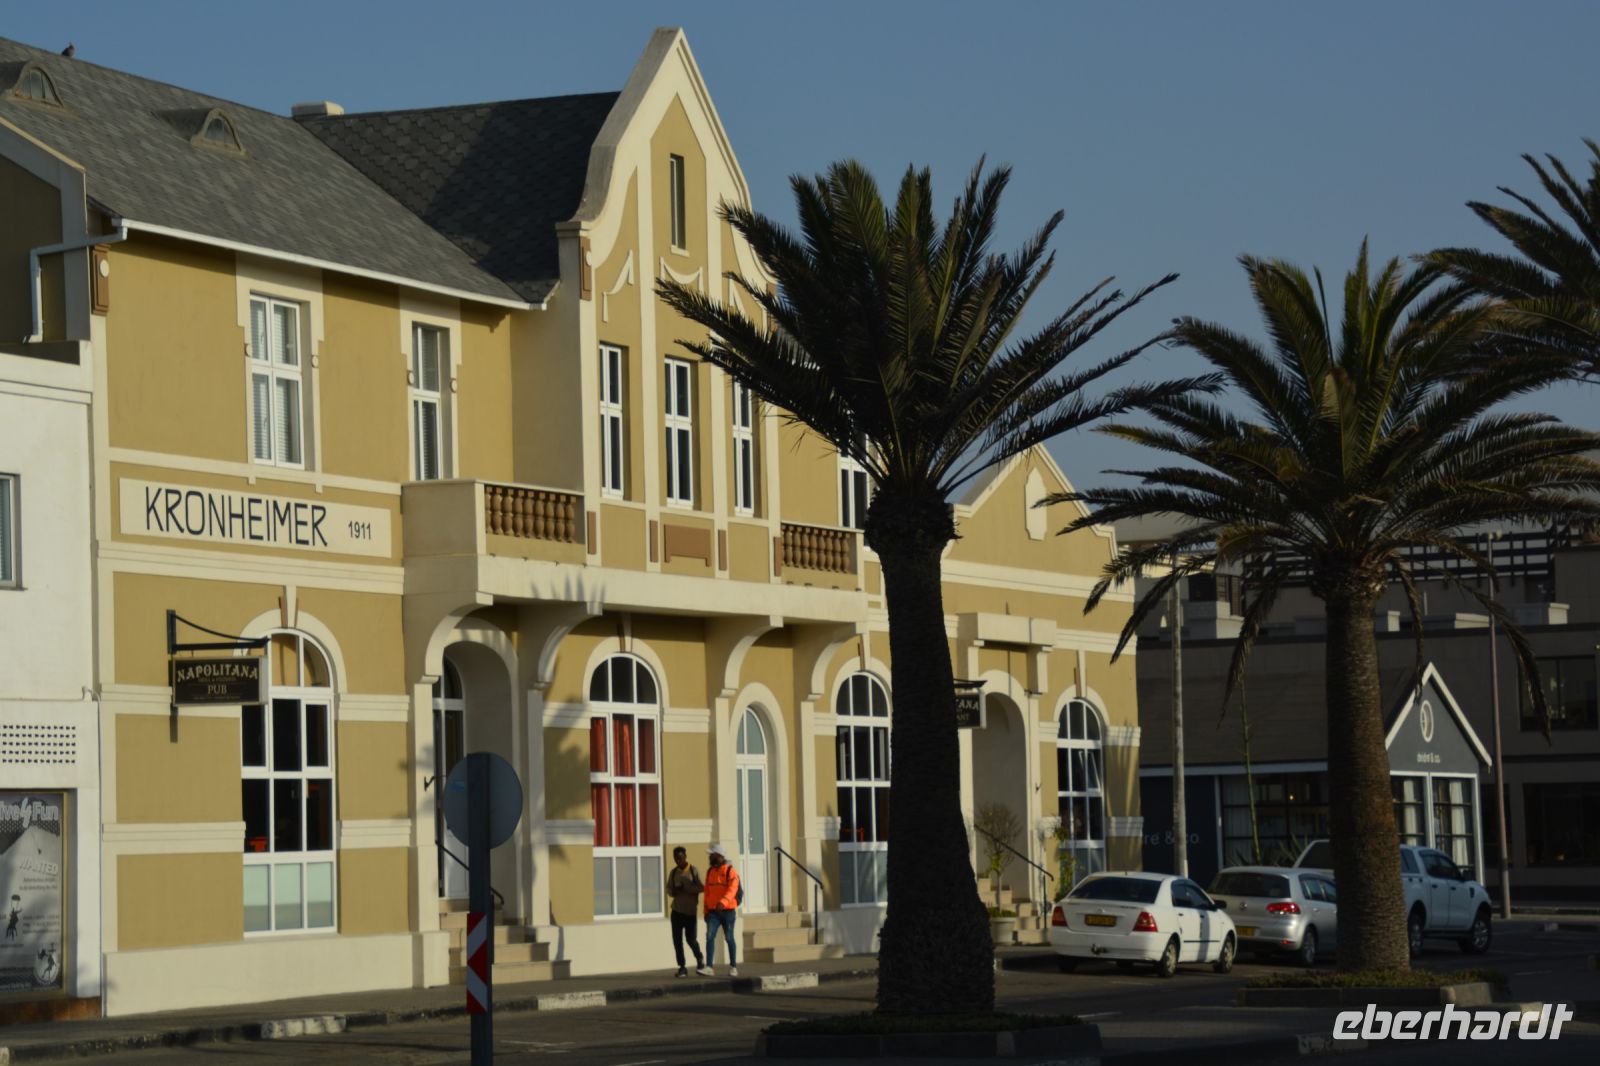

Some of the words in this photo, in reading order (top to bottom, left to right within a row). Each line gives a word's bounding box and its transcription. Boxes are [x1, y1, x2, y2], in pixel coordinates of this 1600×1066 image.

[145, 486, 328, 547] KRONHEIMER
[348, 521, 372, 540] 1911
[177, 663, 258, 683] NAPOLITANA
[207, 684, 228, 695] PUB
